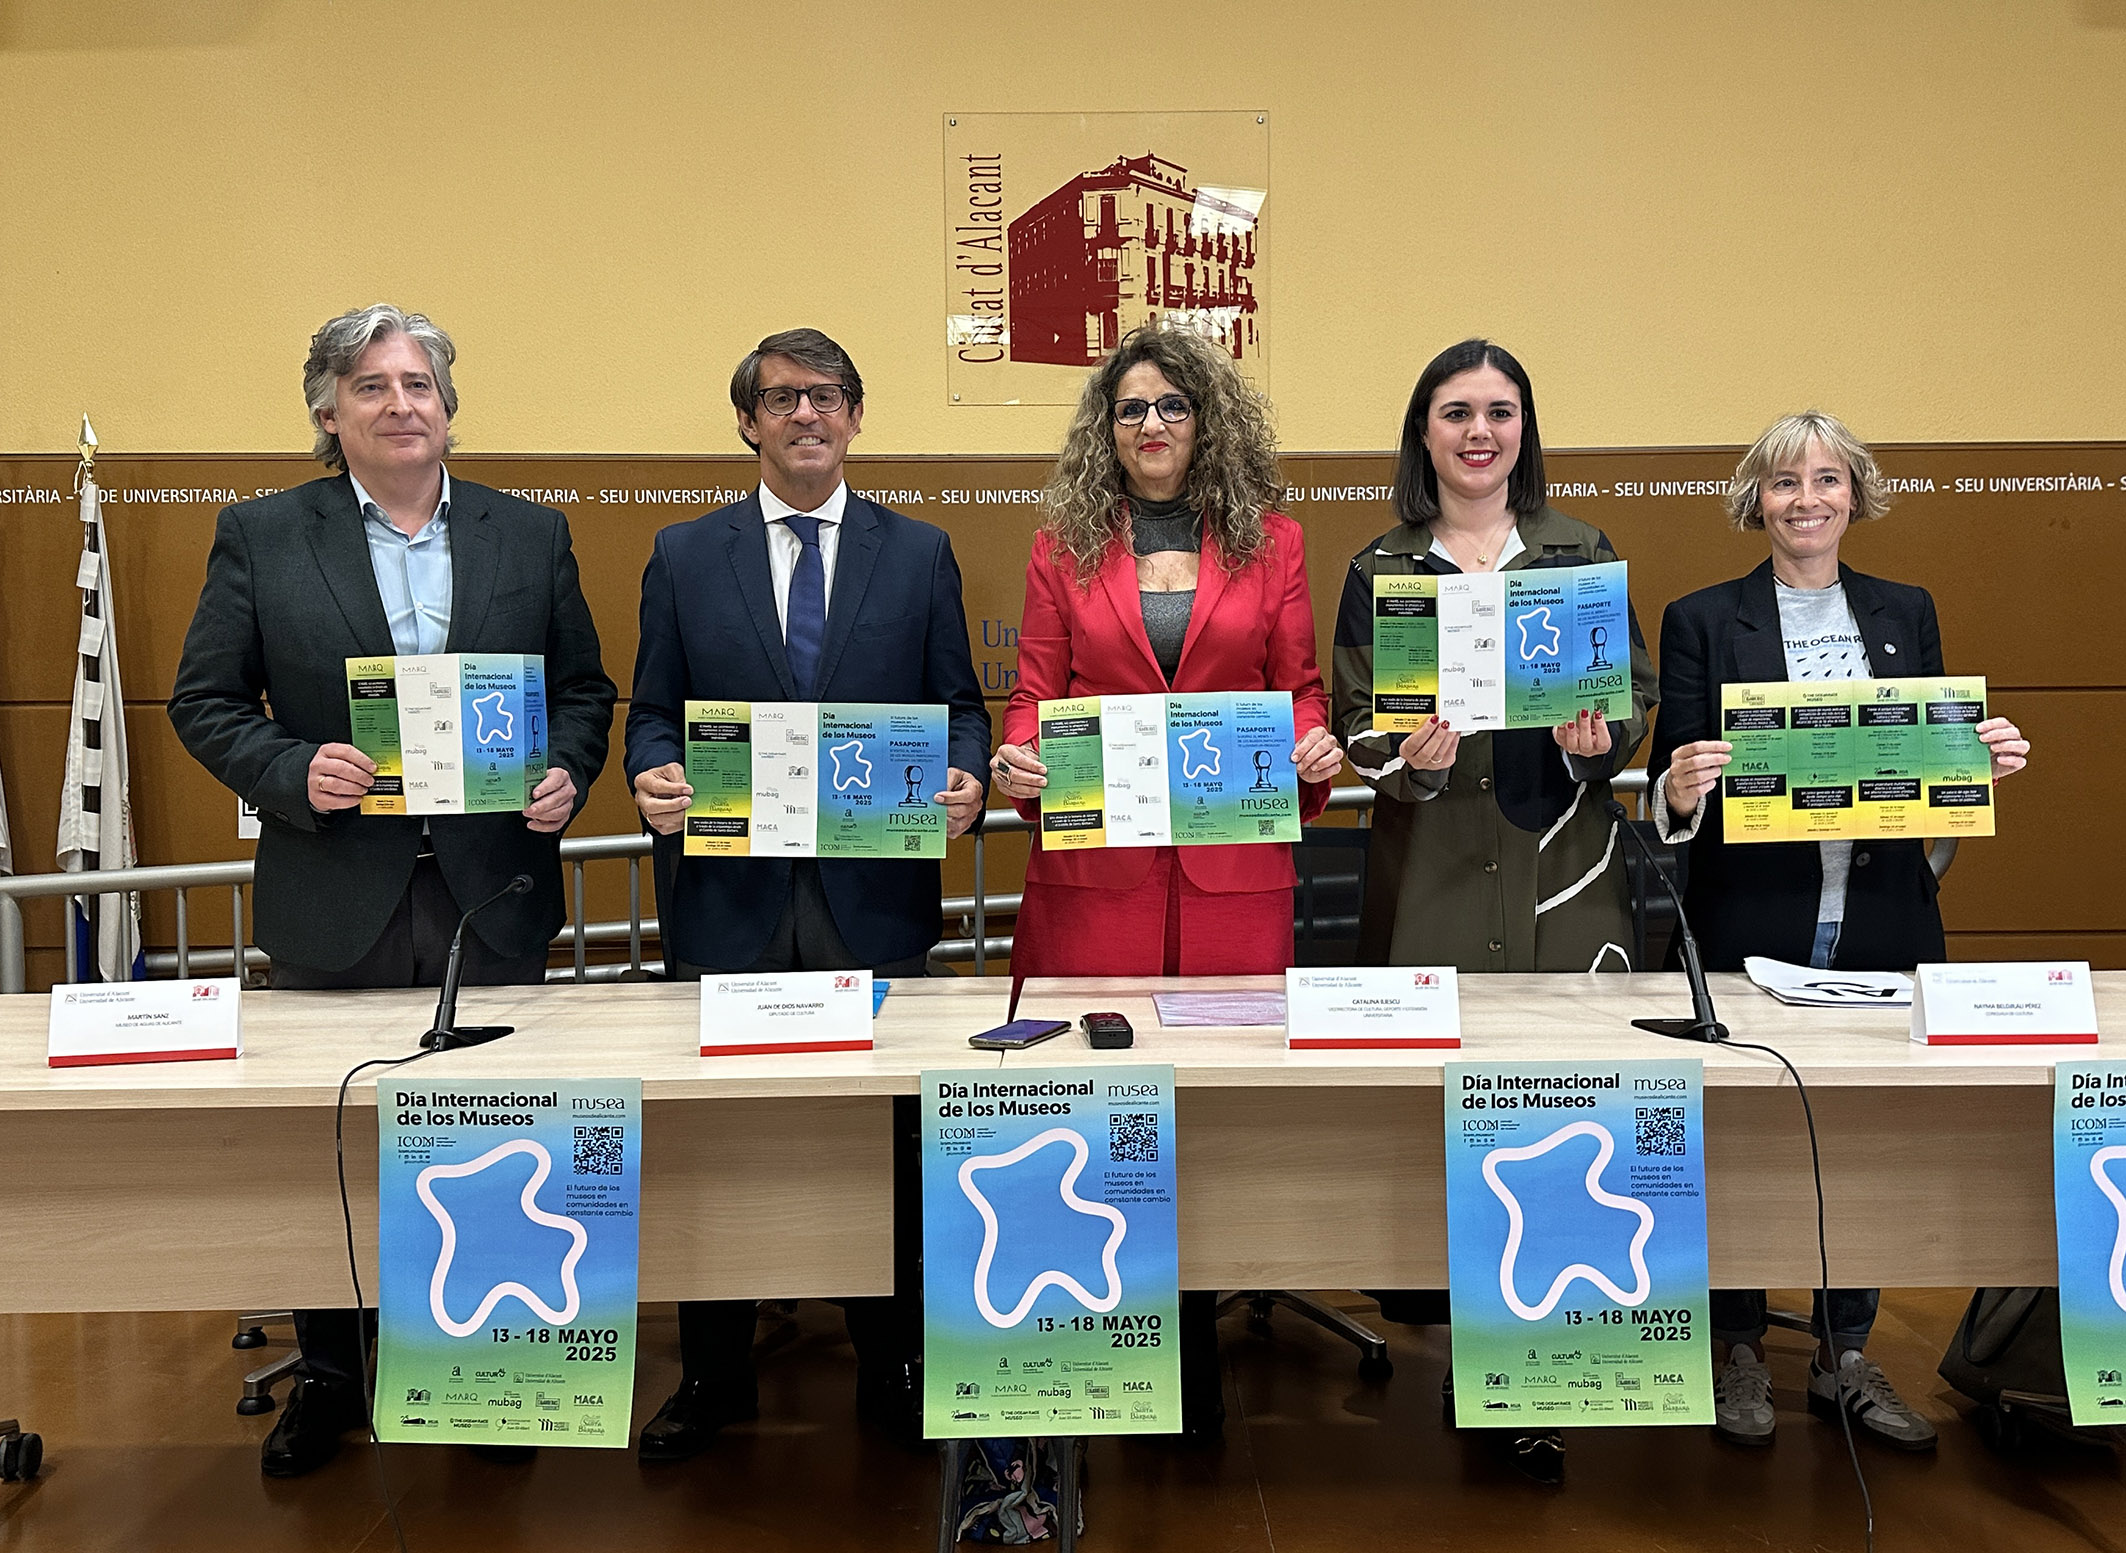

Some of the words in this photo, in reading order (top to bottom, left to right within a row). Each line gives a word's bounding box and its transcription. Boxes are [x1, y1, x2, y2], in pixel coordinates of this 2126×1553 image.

[955, 153, 1004, 277] d'Alacant
[957, 288, 1005, 364] Ciutat
[1954, 478, 1984, 493] SEU
[1989, 471, 2102, 493] UNIVERSITÀRIA
[0, 485, 61, 504] SITÀRIA
[123, 488, 239, 504] UNIVERSITARIA
[599, 488, 629, 504] SEU
[634, 485, 748, 504] UNIVERSITÀRIA
[1283, 487, 1305, 502] EU
[1614, 482, 1643, 498] SEU
[941, 489, 970, 505] SEU
[1389, 582, 1422, 591] MARQ
[1510, 587, 1560, 597] Internacional
[1533, 598, 1564, 606] Museos
[1577, 601, 1611, 610] PASAPORTE
[1783, 640, 1809, 649] THE
[1810, 634, 1851, 647] OCEAN
[358, 663, 385, 674] MARQ
[465, 673, 513, 681] Internacional
[1578, 674, 1622, 691] musea
[702, 708, 735, 717] MARQ
[1053, 703, 1085, 714] MARQ
[823, 722, 873, 730] Internacional
[846, 732, 876, 740] Museos
[889, 740, 930, 748] PASAPORTE
[1742, 762, 1769, 770] MACA
[1942, 775, 1972, 783] mubag
[755, 791, 779, 799] mubag
[1241, 798, 1289, 810] musea
[889, 812, 937, 825] musea
[1462, 1074, 1492, 1091] Día
[1497, 1072, 1620, 1091] Internacional
[1634, 1078, 1686, 1091] musea
[2072, 1073, 2101, 1090] Día
[939, 1083, 968, 1099] Día
[973, 1080, 1094, 1098] Internacional
[1107, 1084, 1159, 1098] musea
[396, 1091, 427, 1108] Día
[432, 1091, 558, 1108] Internacional
[572, 1097, 625, 1110] musea
[1462, 1093, 1487, 1109] de
[1491, 1093, 1518, 1109] los
[1522, 1093, 1596, 1109] Museos
[2071, 1092, 2095, 1108] de
[2100, 1092, 2126, 1108] los
[939, 1101, 964, 1118] de
[968, 1101, 995, 1117] los
[999, 1100, 1071, 1117] Museos
[397, 1110, 422, 1126] de
[427, 1110, 455, 1126] los
[459, 1110, 534, 1126] Museos
[2071, 1118, 2107, 1130] ICOM
[1462, 1119, 1499, 1131] ICOM
[939, 1127, 975, 1140] ICOM
[397, 1136, 434, 1147] ICOM
[1112, 1171, 1133, 1179] futuro
[1630, 1165, 1637, 1173] El
[1638, 1165, 1660, 1173] futuro
[1661, 1165, 1672, 1173] de
[1672, 1165, 1684, 1173] los
[574, 1184, 596, 1192] futuro
[1669, 1190, 1700, 1198] cambio
[566, 1201, 617, 1209] comunidades
[1142, 1196, 1171, 1204] cambio
[1037, 1317, 1054, 1332] 13
[1070, 1316, 1095, 1331] 18
[1102, 1315, 1162, 1331] MAYO
[1564, 1310, 1582, 1325] 13
[1599, 1309, 1623, 1325] 18
[1631, 1309, 1692, 1325] MAYO
[492, 1328, 509, 1343] 13
[526, 1328, 550, 1343] 18
[558, 1329, 618, 1344] MAYO
[1111, 1332, 1161, 1348] 2025
[1640, 1326, 1692, 1341] 2025
[565, 1346, 617, 1361] 2025
[1524, 1375, 1557, 1385] MARQ
[1568, 1378, 1602, 1391] mubag
[1653, 1373, 1684, 1384] MACA
[995, 1384, 1028, 1394] MARQ
[1037, 1387, 1072, 1399] mubag
[1123, 1381, 1153, 1391] MACA
[445, 1392, 478, 1402] MARQ
[488, 1396, 522, 1409] mubag
[573, 1394, 604, 1405] MACA
